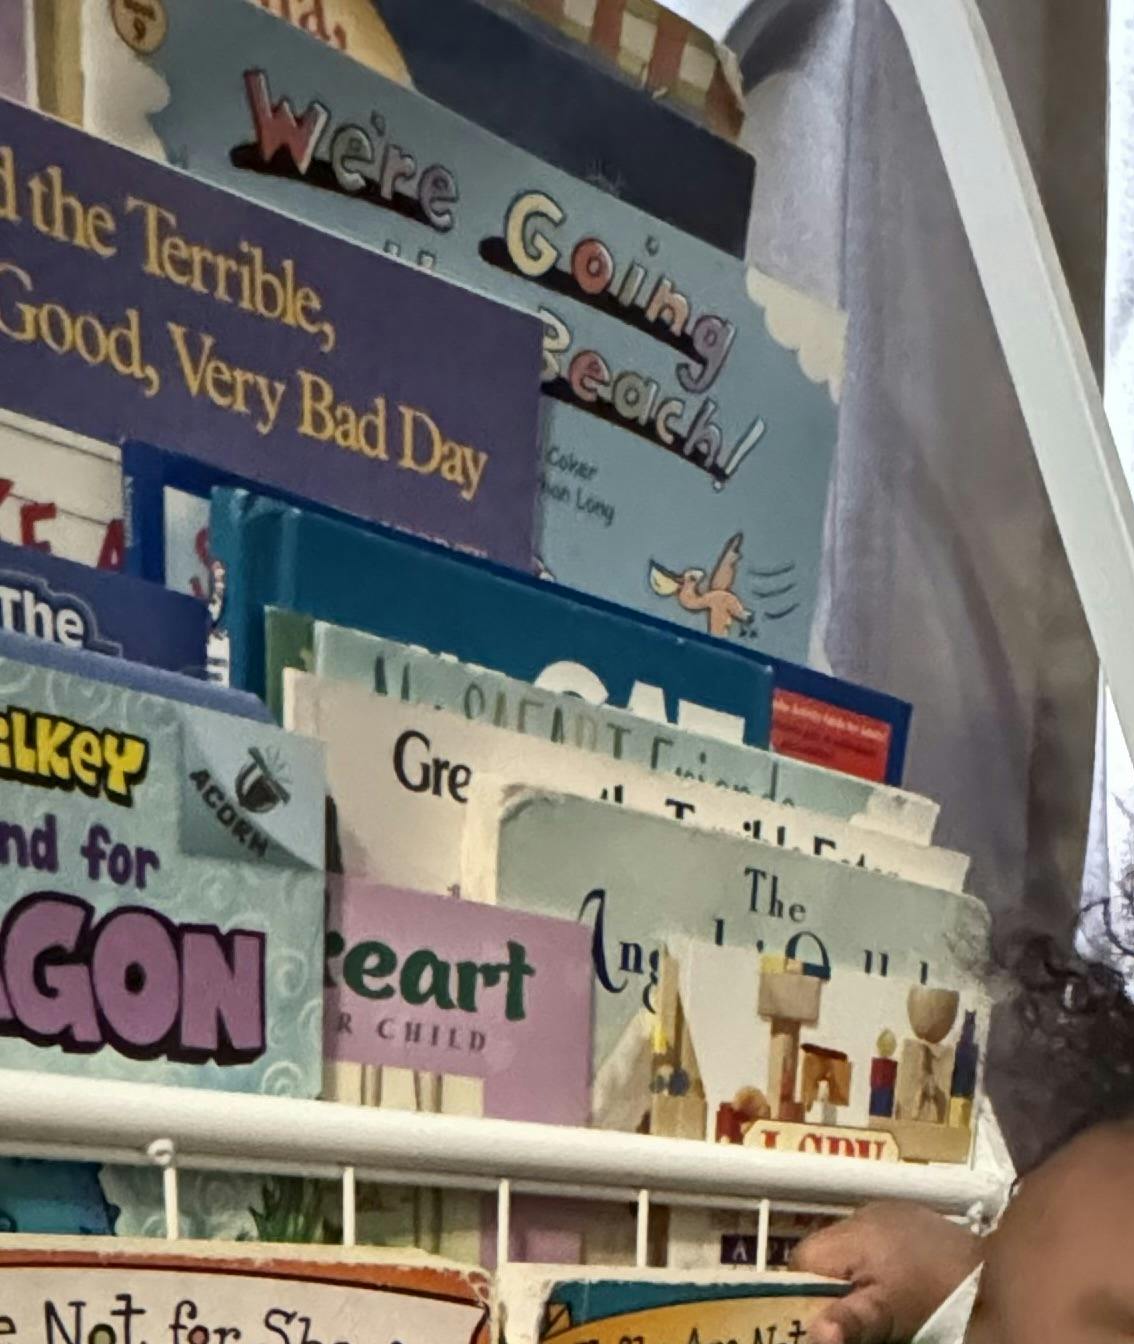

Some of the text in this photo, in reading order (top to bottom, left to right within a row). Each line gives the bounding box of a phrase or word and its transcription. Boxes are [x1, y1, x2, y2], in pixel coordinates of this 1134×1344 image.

[242, 66, 460, 232] We're
[28, 165, 117, 258] the
[125, 193, 336, 353] Terrible,
[505, 190, 737, 394] Going
[0, 262, 489, 501] Good, Very Bad Day
[541, 306, 766, 492] Beach!
[0, 583, 85, 648] The
[80, 822, 160, 889] for
[189, 768, 268, 858] ACORN
[744, 866, 807, 924] The
[0, 890, 267, 1066] GON
[376, 1016, 488, 1051] CHILD
